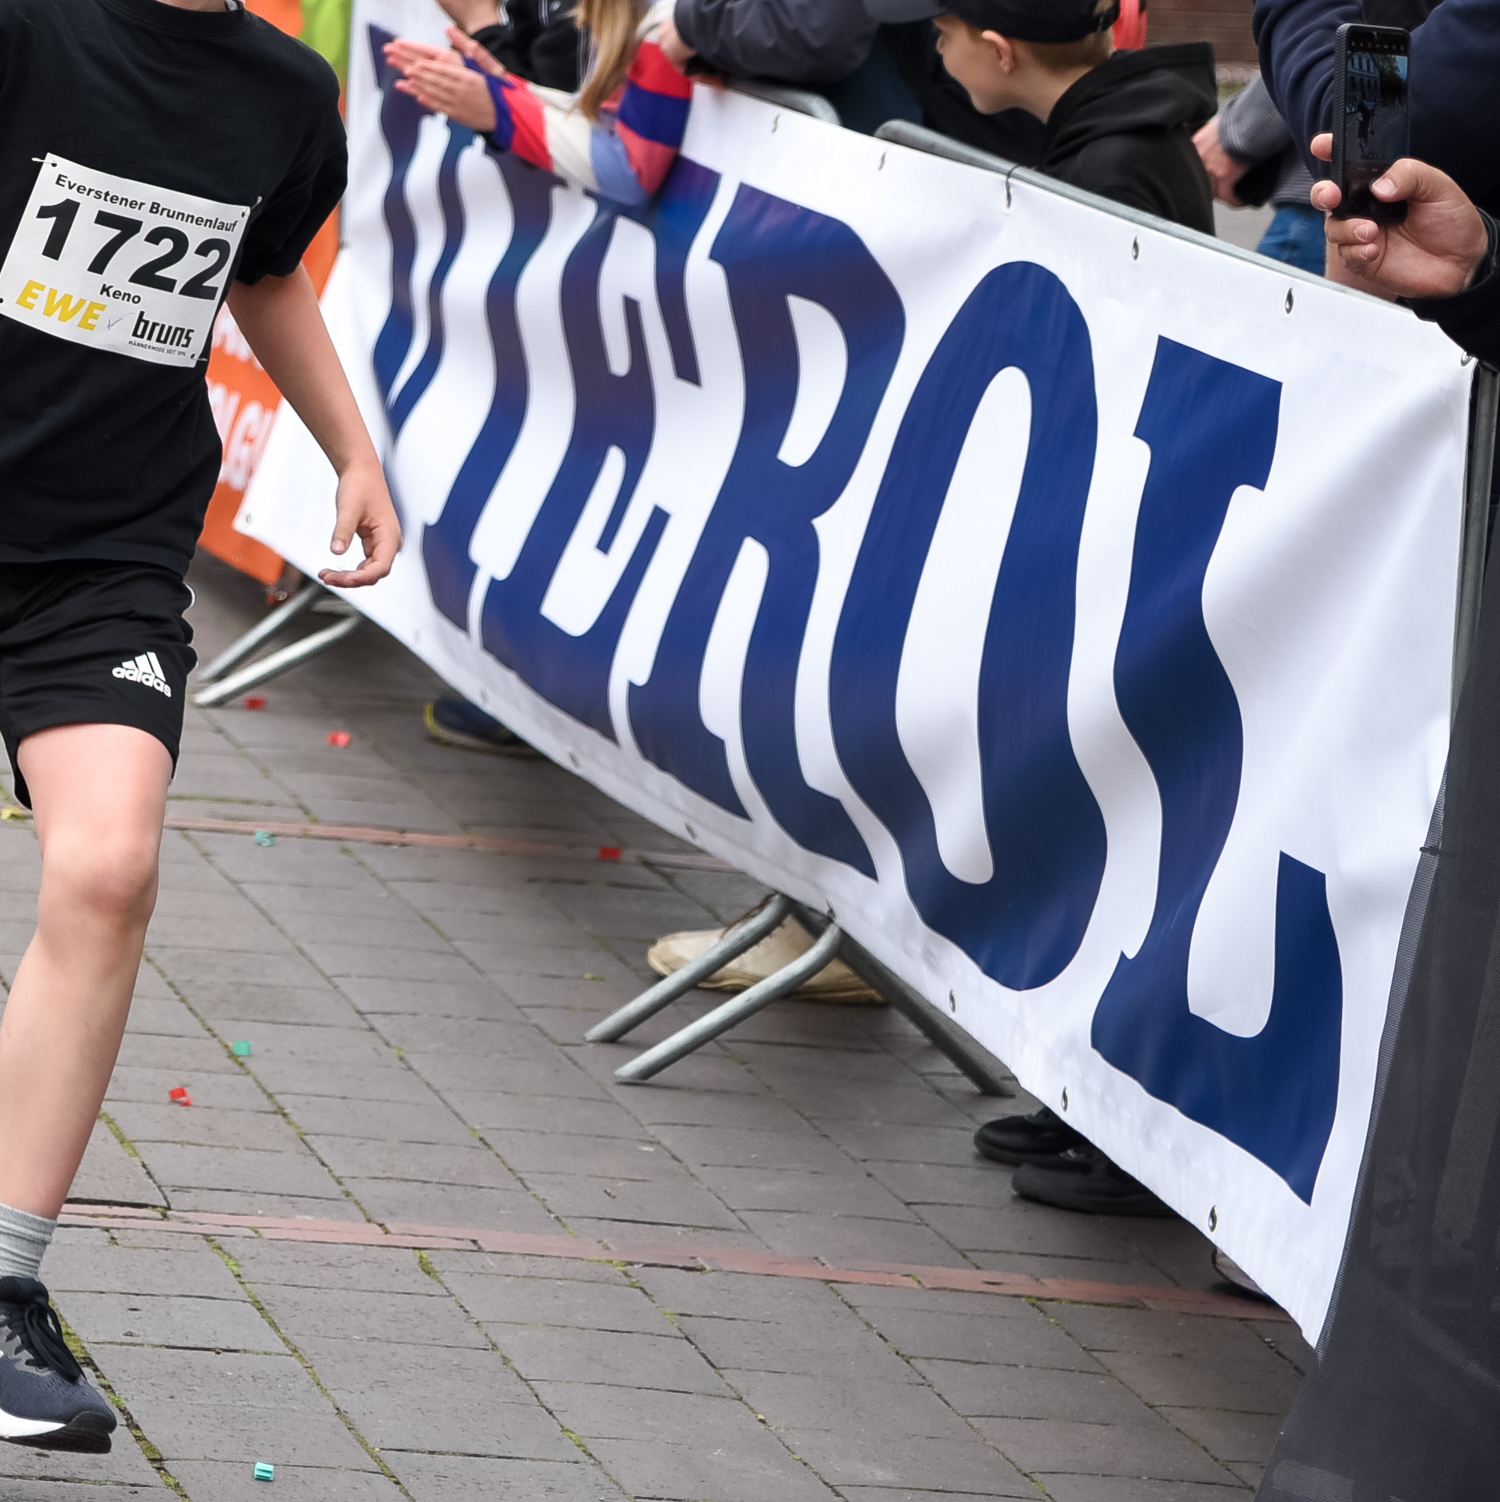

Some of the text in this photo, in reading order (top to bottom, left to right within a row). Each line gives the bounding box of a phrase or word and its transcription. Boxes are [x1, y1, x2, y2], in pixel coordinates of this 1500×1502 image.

[55, 173, 239, 233] Everstener Brunnenlauf
[35, 197, 232, 301] 1722
[15, 279, 107, 331] EWE
[99, 283, 142, 305] Keno
[131, 310, 195, 348] bruns
[111, 666, 172, 698] adidas
